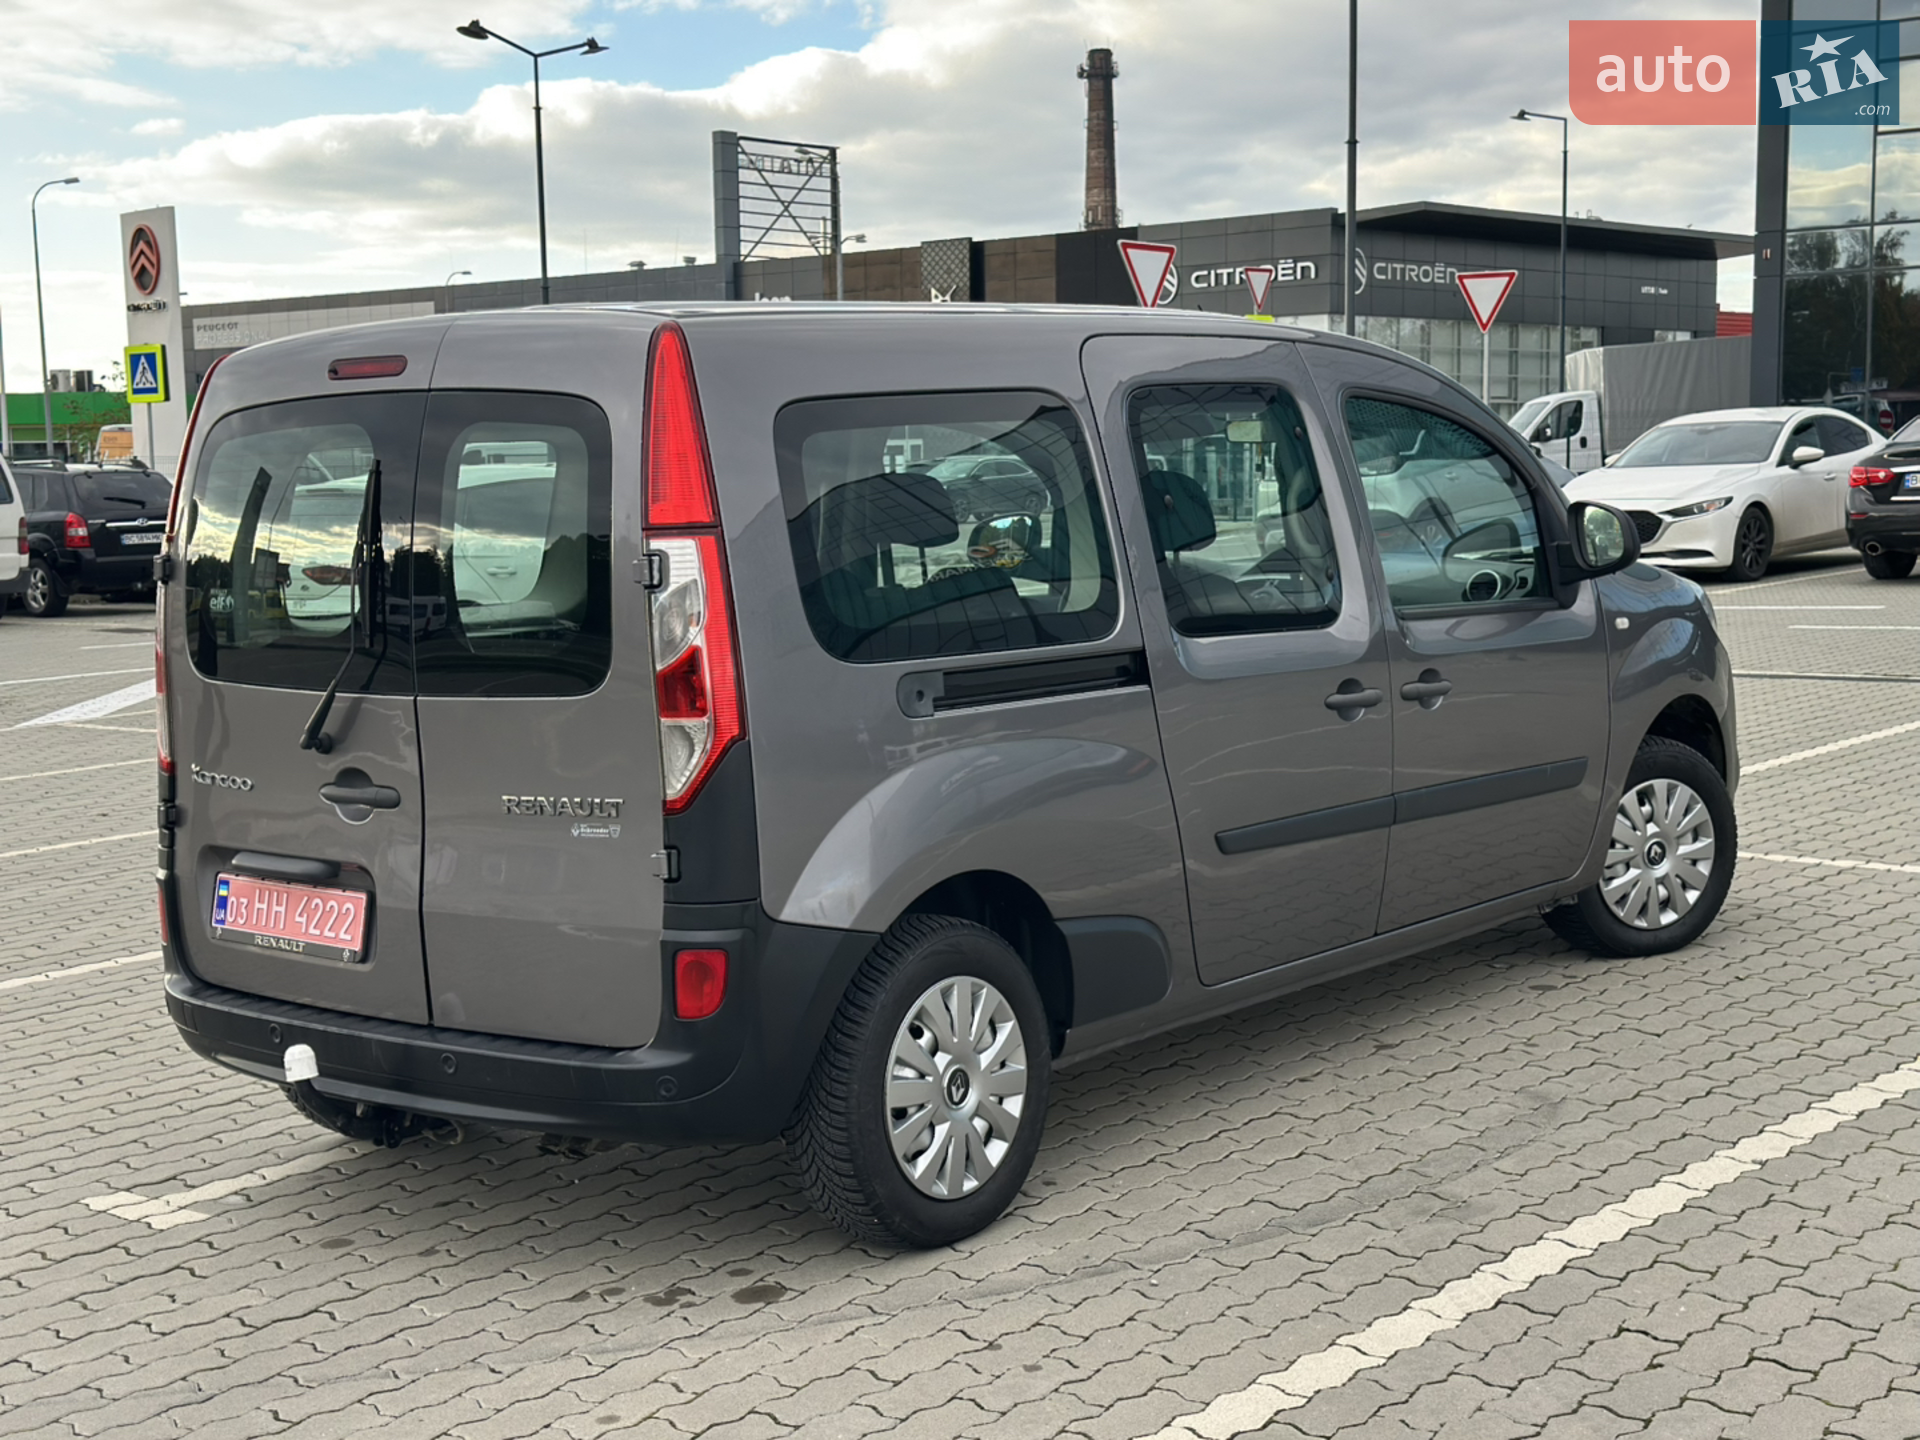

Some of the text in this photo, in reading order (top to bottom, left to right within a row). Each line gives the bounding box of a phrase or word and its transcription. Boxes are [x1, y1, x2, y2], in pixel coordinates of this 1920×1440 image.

[196, 322, 239, 332] PEUGEOT
[191, 763, 254, 791] Kangoo
[501, 795, 624, 818] RENAULT
[215, 908, 225, 921] UA
[226, 888, 356, 942] 03 HH 4222
[254, 934, 306, 953] RENAULT
